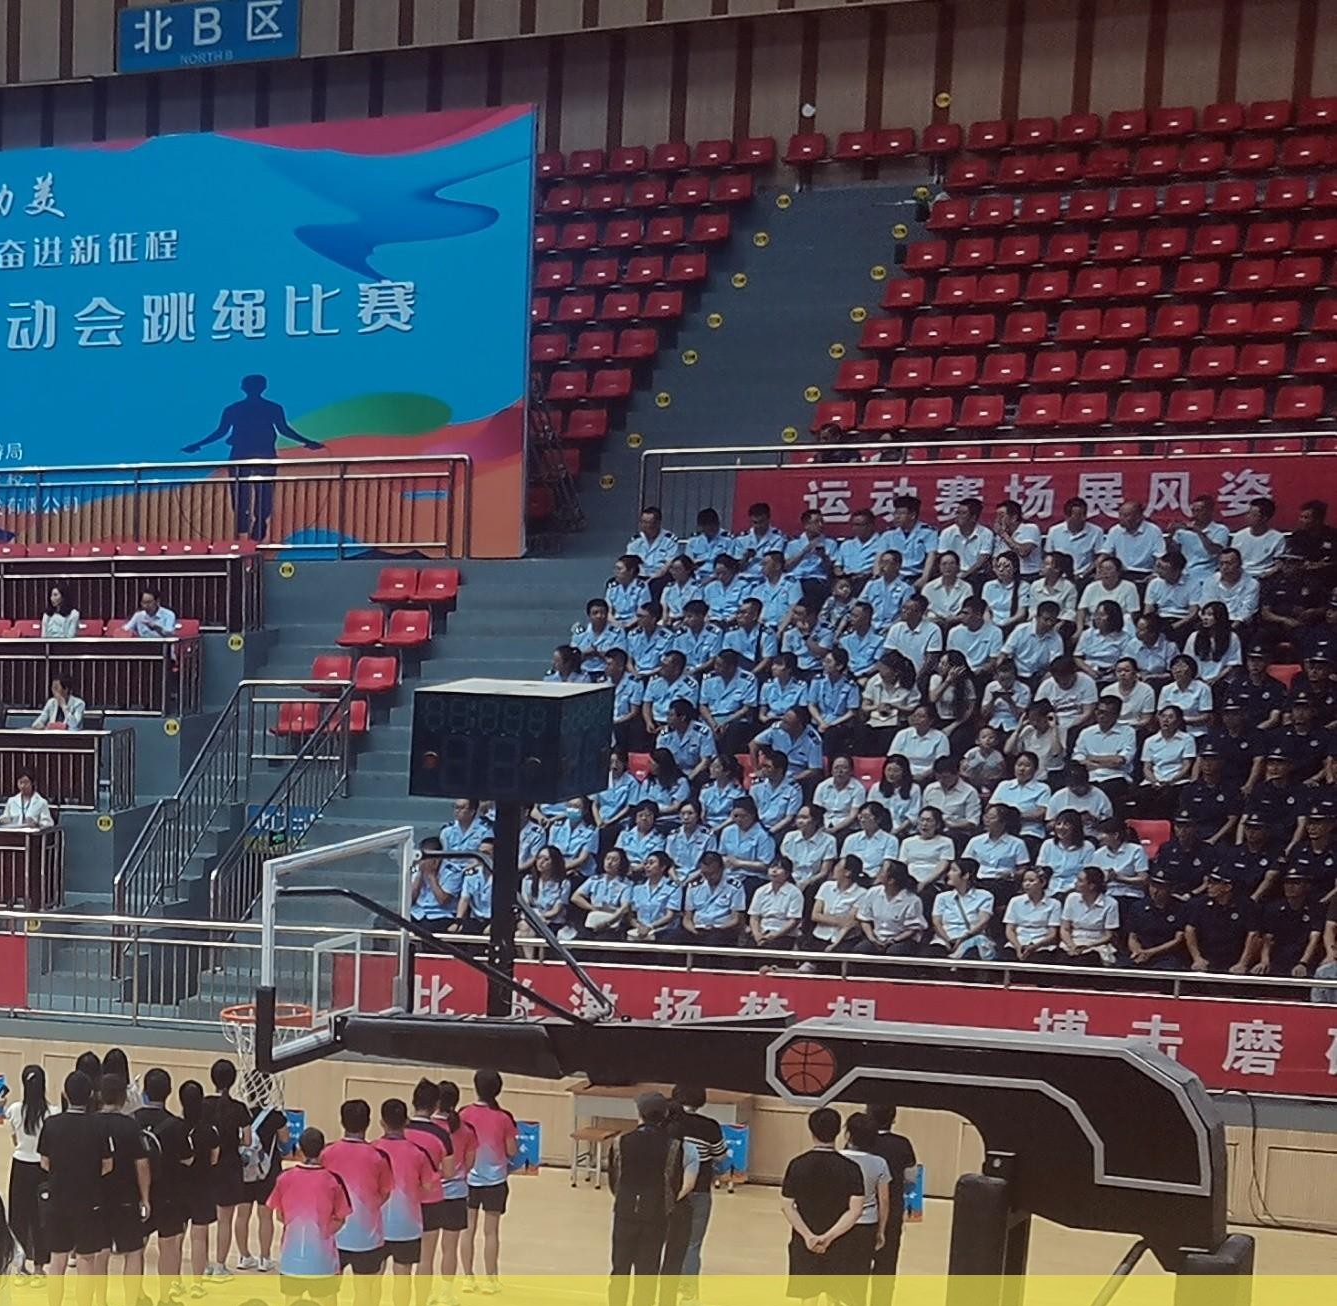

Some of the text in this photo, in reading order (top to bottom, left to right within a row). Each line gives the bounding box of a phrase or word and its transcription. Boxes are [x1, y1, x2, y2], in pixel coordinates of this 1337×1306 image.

[803, 468, 1274, 524] 运动赛场展风姿
